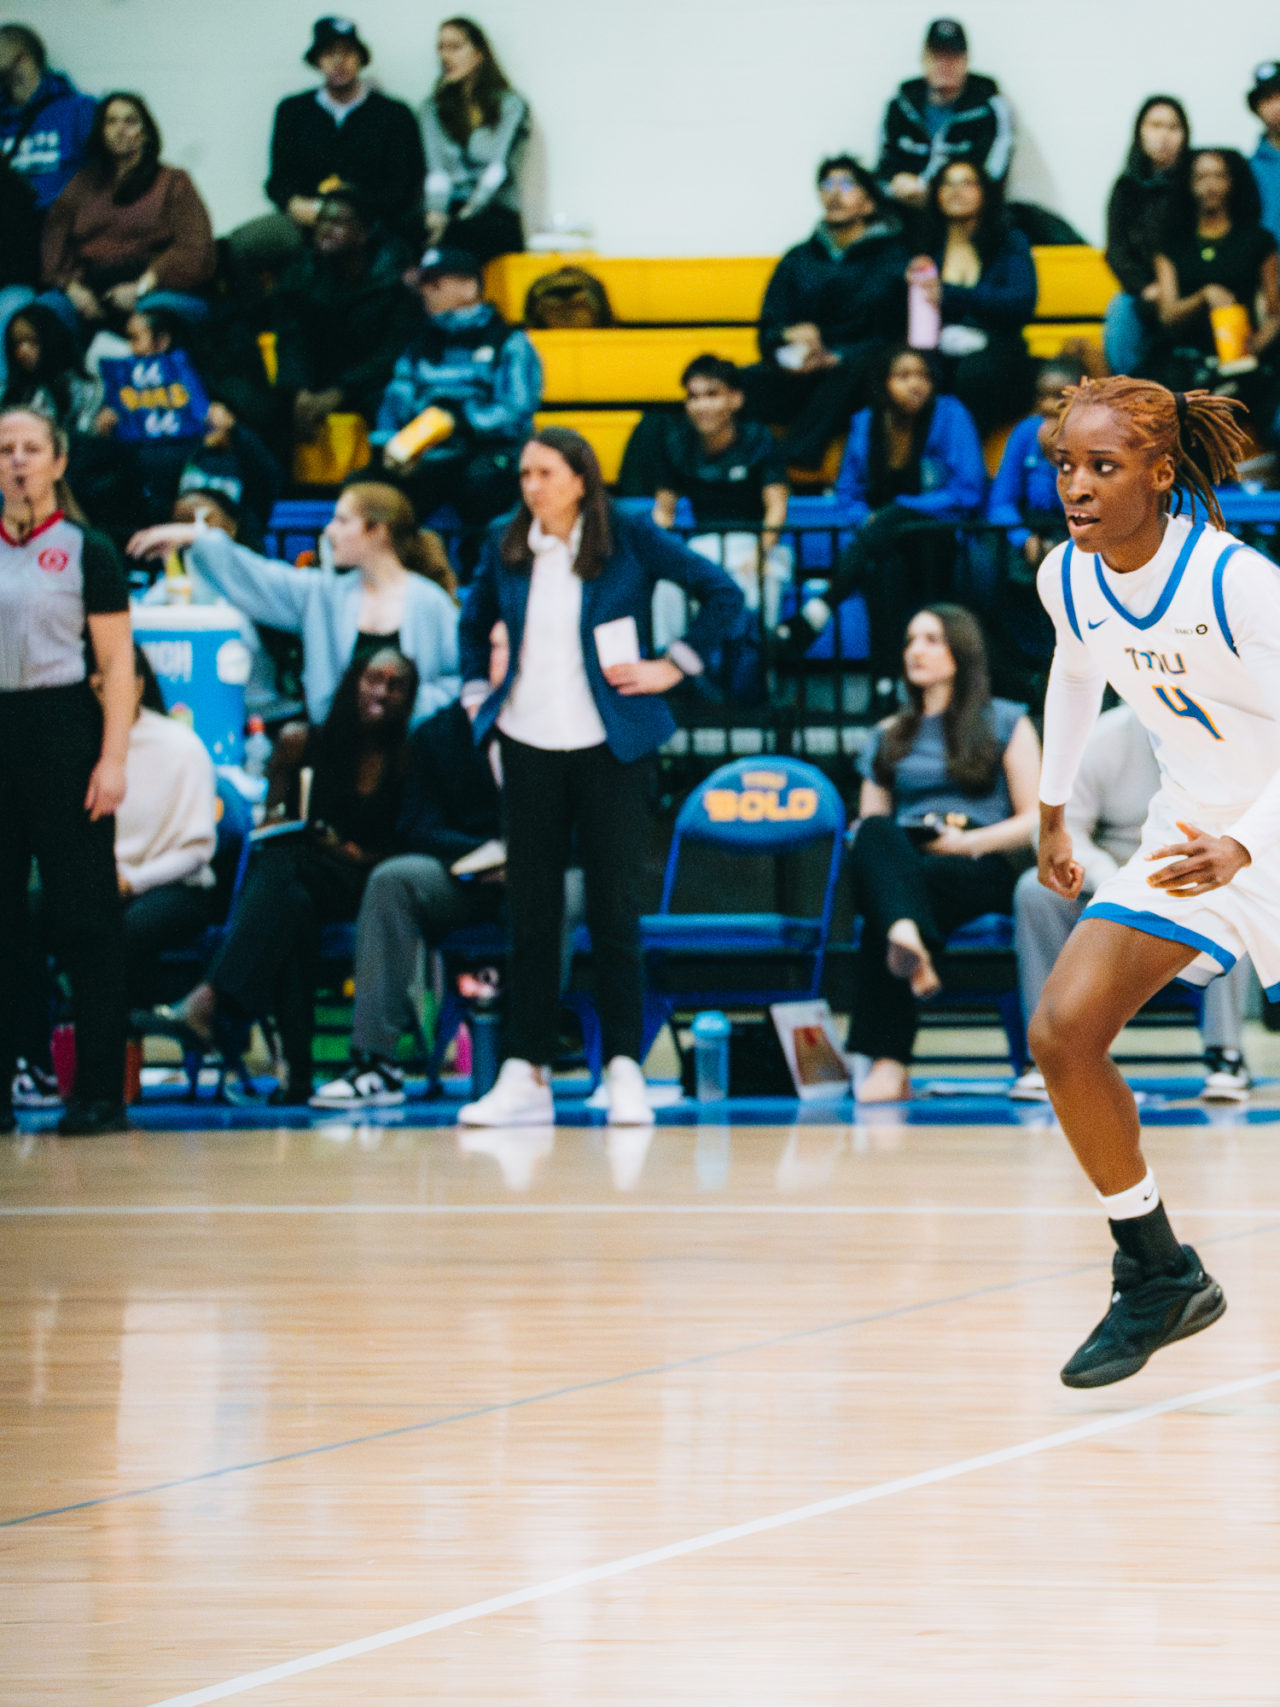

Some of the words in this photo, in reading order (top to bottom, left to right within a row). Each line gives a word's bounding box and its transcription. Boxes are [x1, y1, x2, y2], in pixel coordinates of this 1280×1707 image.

[1124, 647, 1187, 675] TMU
[1151, 684, 1226, 742] 4
[703, 787, 818, 822] BOLD
